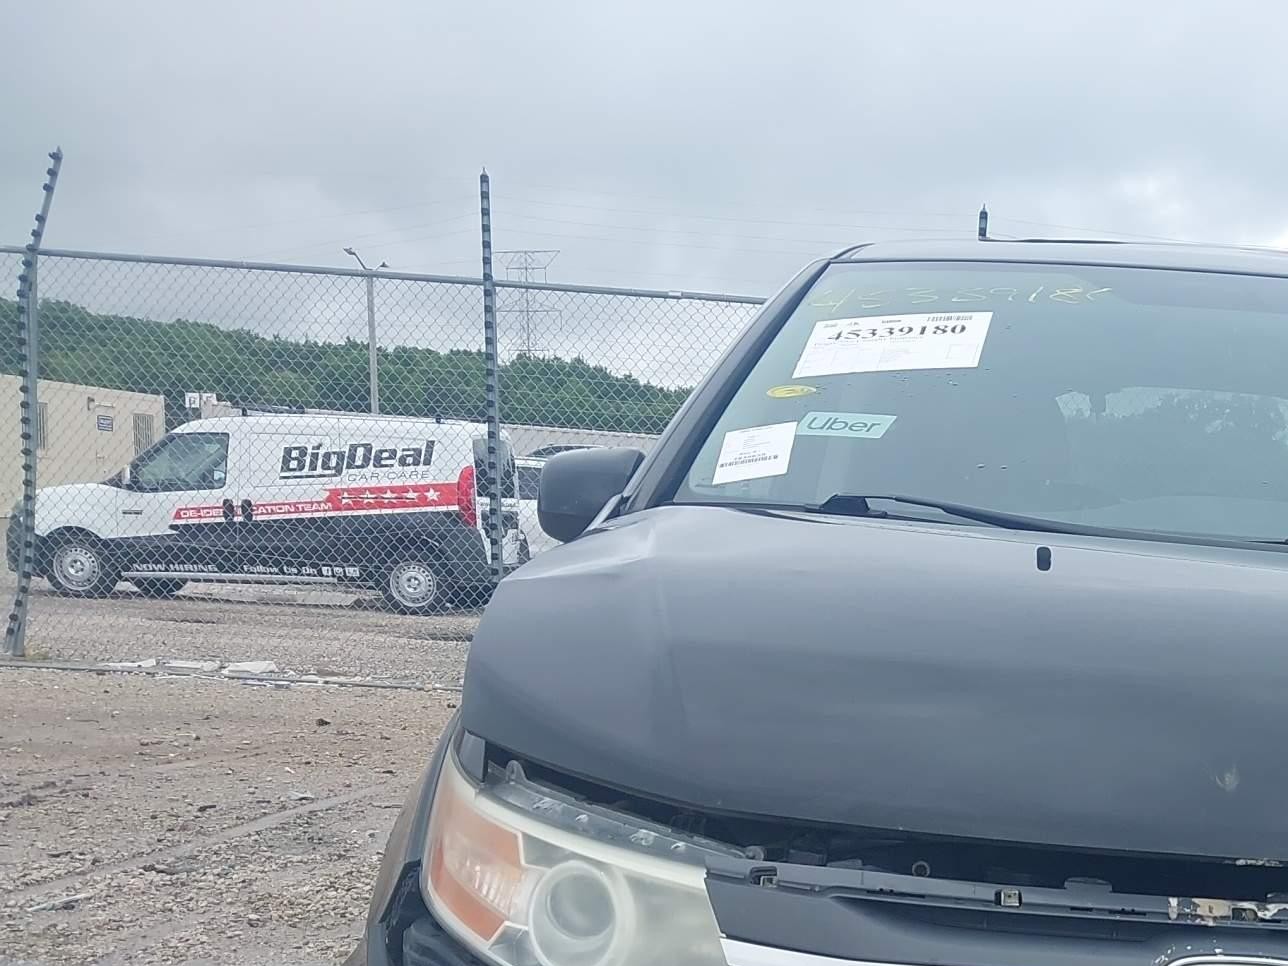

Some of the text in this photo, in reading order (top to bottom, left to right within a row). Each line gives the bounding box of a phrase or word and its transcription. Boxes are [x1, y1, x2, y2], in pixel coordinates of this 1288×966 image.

[827, 323, 967, 341] 45339180
[806, 416, 881, 433] Uber
[279, 440, 436, 479] BigDeal
[347, 470, 430, 482] CAR CARE
[295, 502, 333, 513] TEAM
[132, 563, 219, 572] NOW HIRING
[243, 564, 280, 574] Follow
